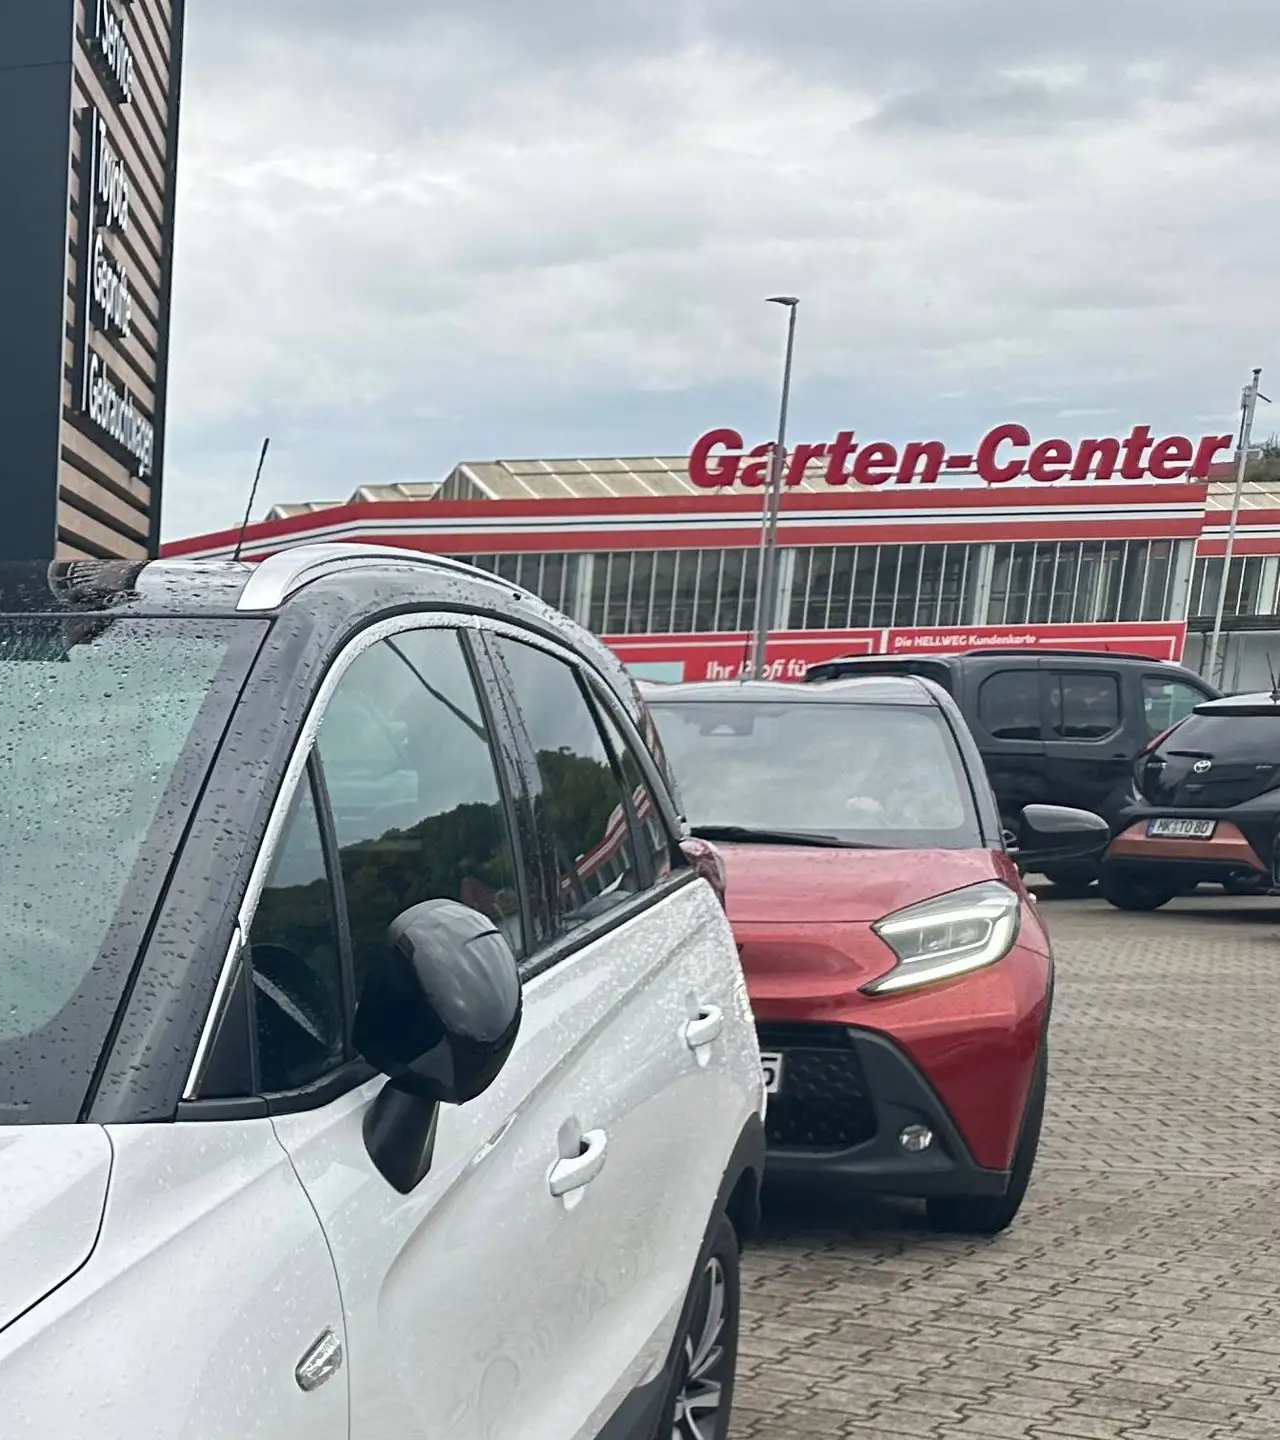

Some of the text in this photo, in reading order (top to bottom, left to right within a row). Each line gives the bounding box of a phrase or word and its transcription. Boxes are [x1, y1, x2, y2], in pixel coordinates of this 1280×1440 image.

[98, 116, 129, 233] Toyota
[688, 424, 1233, 488] Garten-Center
[706, 660, 735, 680] Ihr
[738, 658, 786, 681] Pofi
